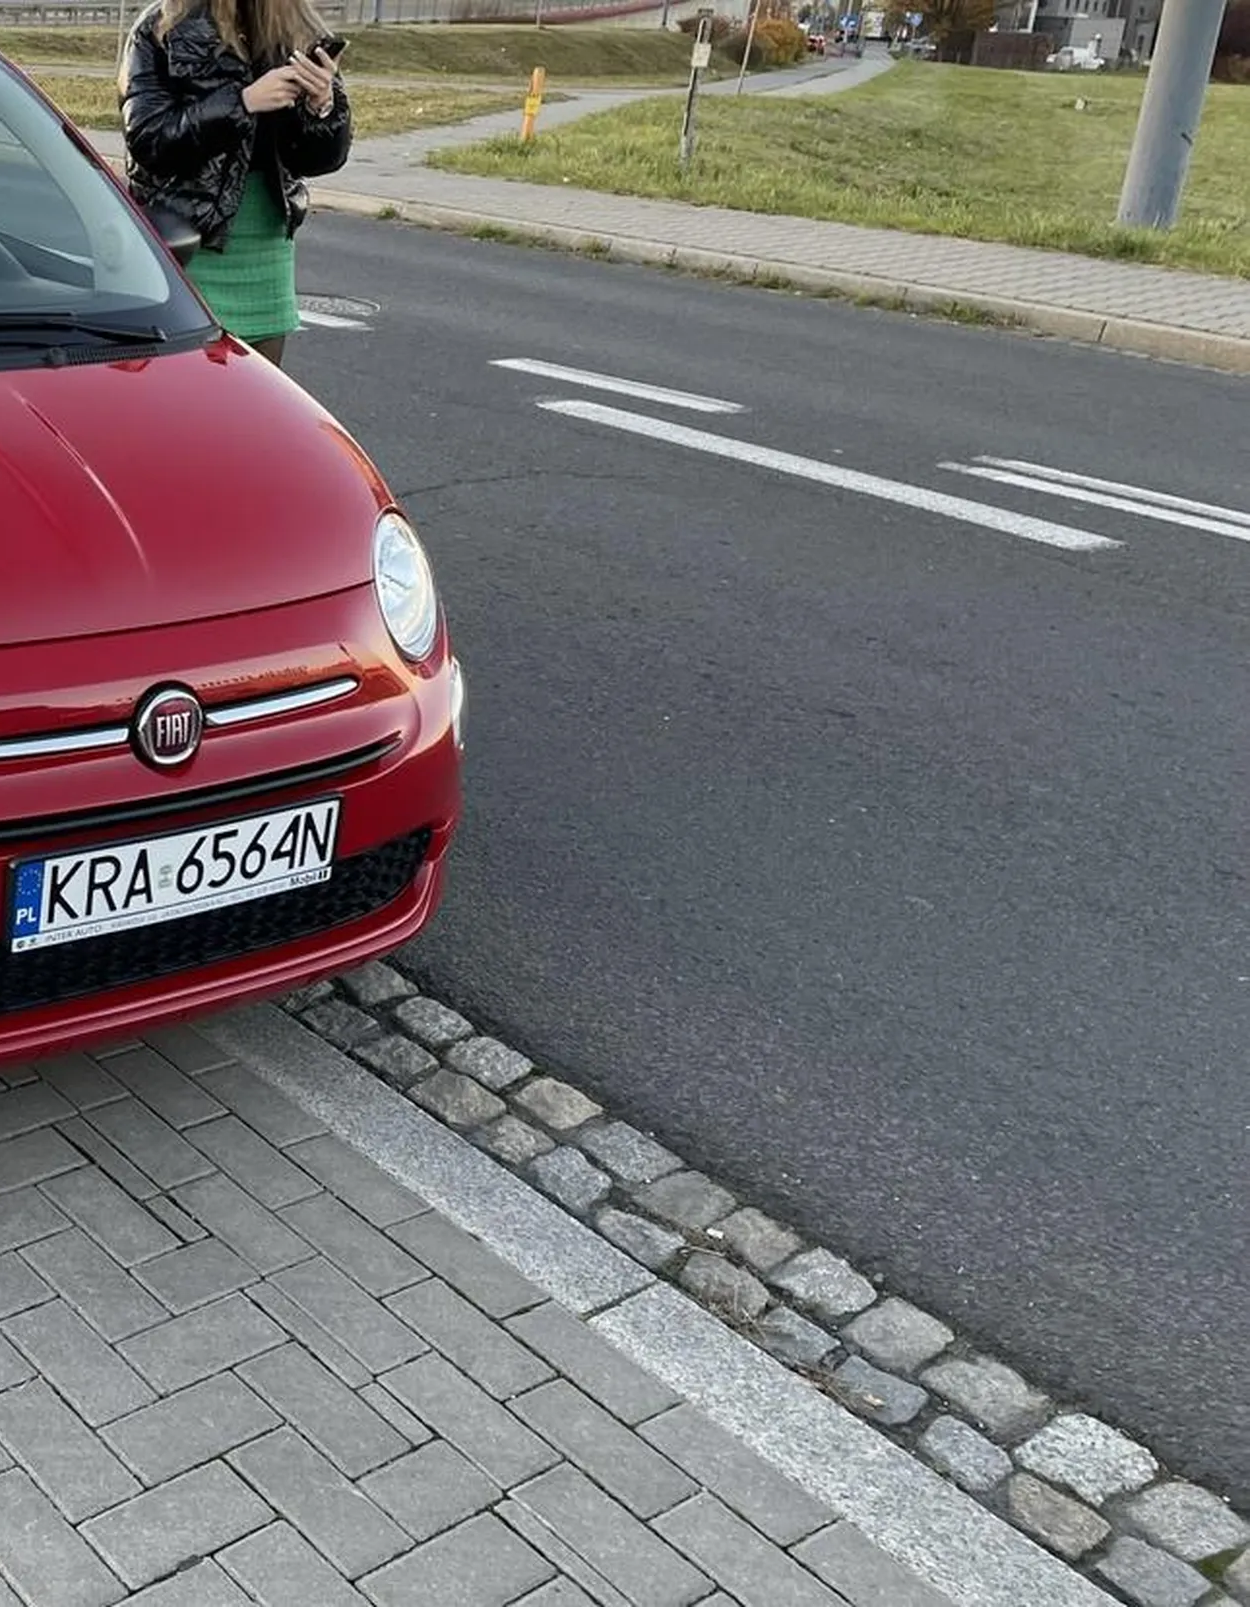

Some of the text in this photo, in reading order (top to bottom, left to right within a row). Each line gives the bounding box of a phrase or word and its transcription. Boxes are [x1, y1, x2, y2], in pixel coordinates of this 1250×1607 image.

[156, 712, 191, 747] FIAT
[47, 848, 153, 924] KRA
[176, 807, 334, 895] 6564N
[15, 908, 38, 925] PL
